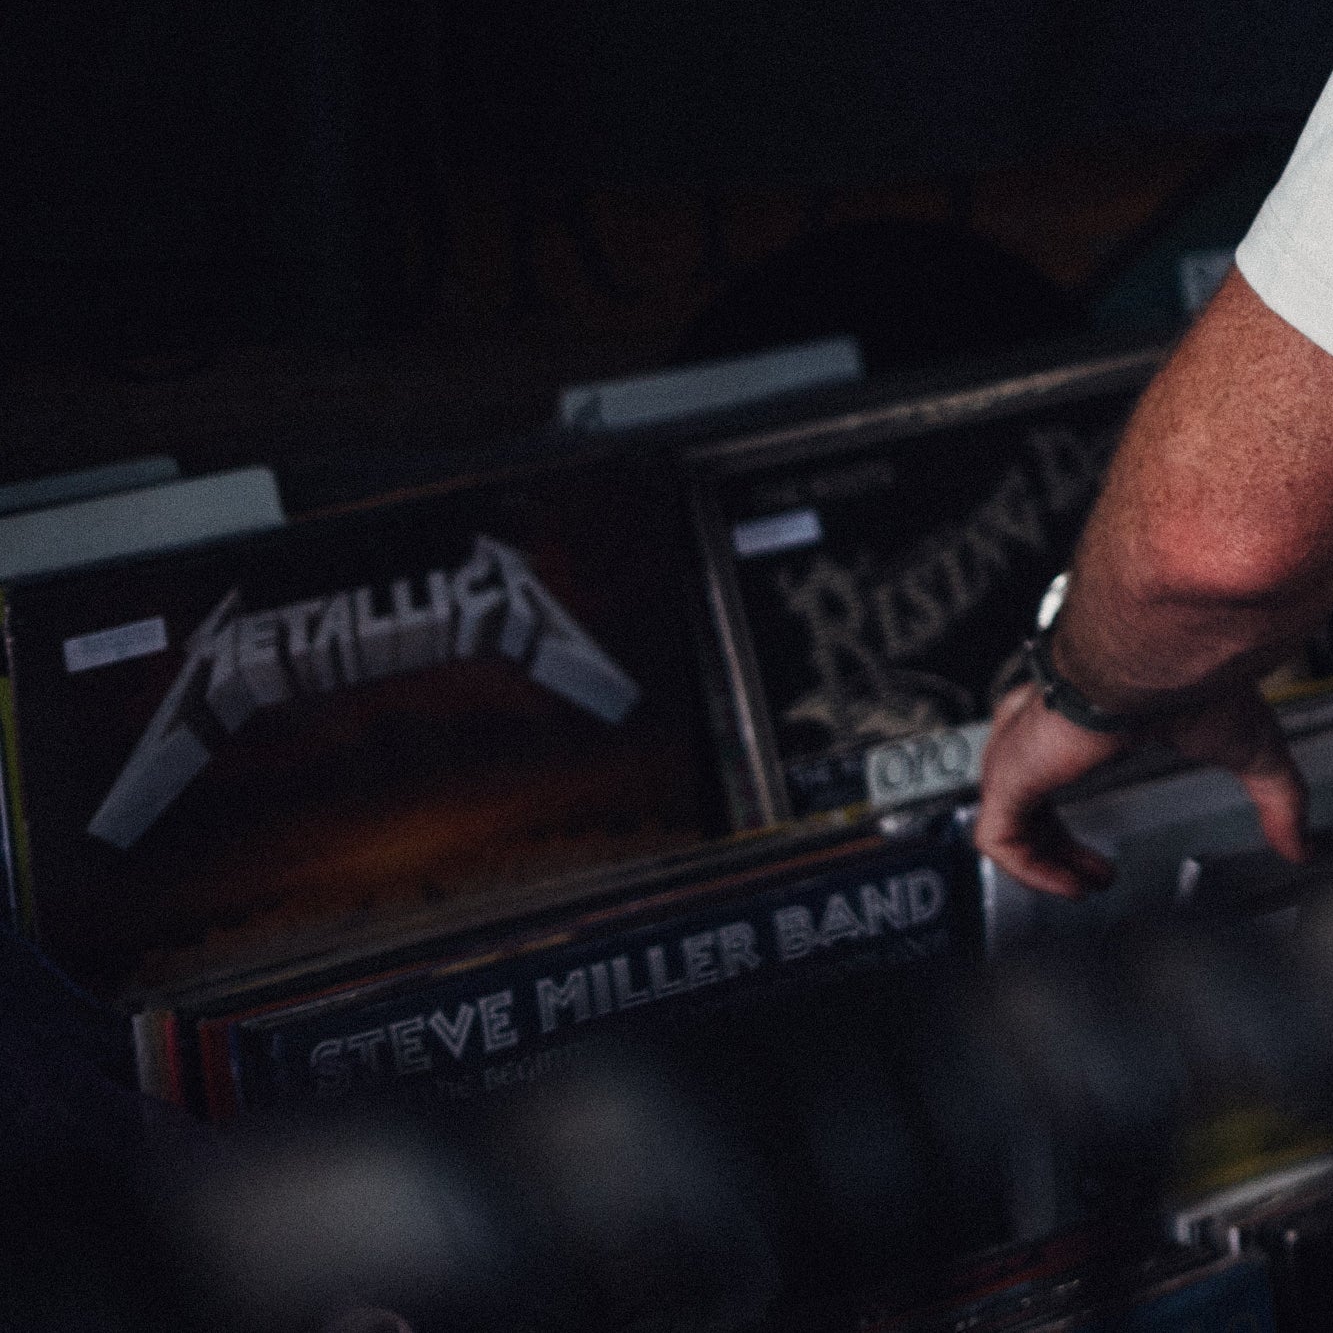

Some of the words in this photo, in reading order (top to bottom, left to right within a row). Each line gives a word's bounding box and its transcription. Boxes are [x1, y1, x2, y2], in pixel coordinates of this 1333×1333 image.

[84, 530, 645, 854] METALLICA
[307, 988, 520, 1098] STEVE
[534, 918, 764, 1036] MILLER
[772, 867, 948, 963] BAND
